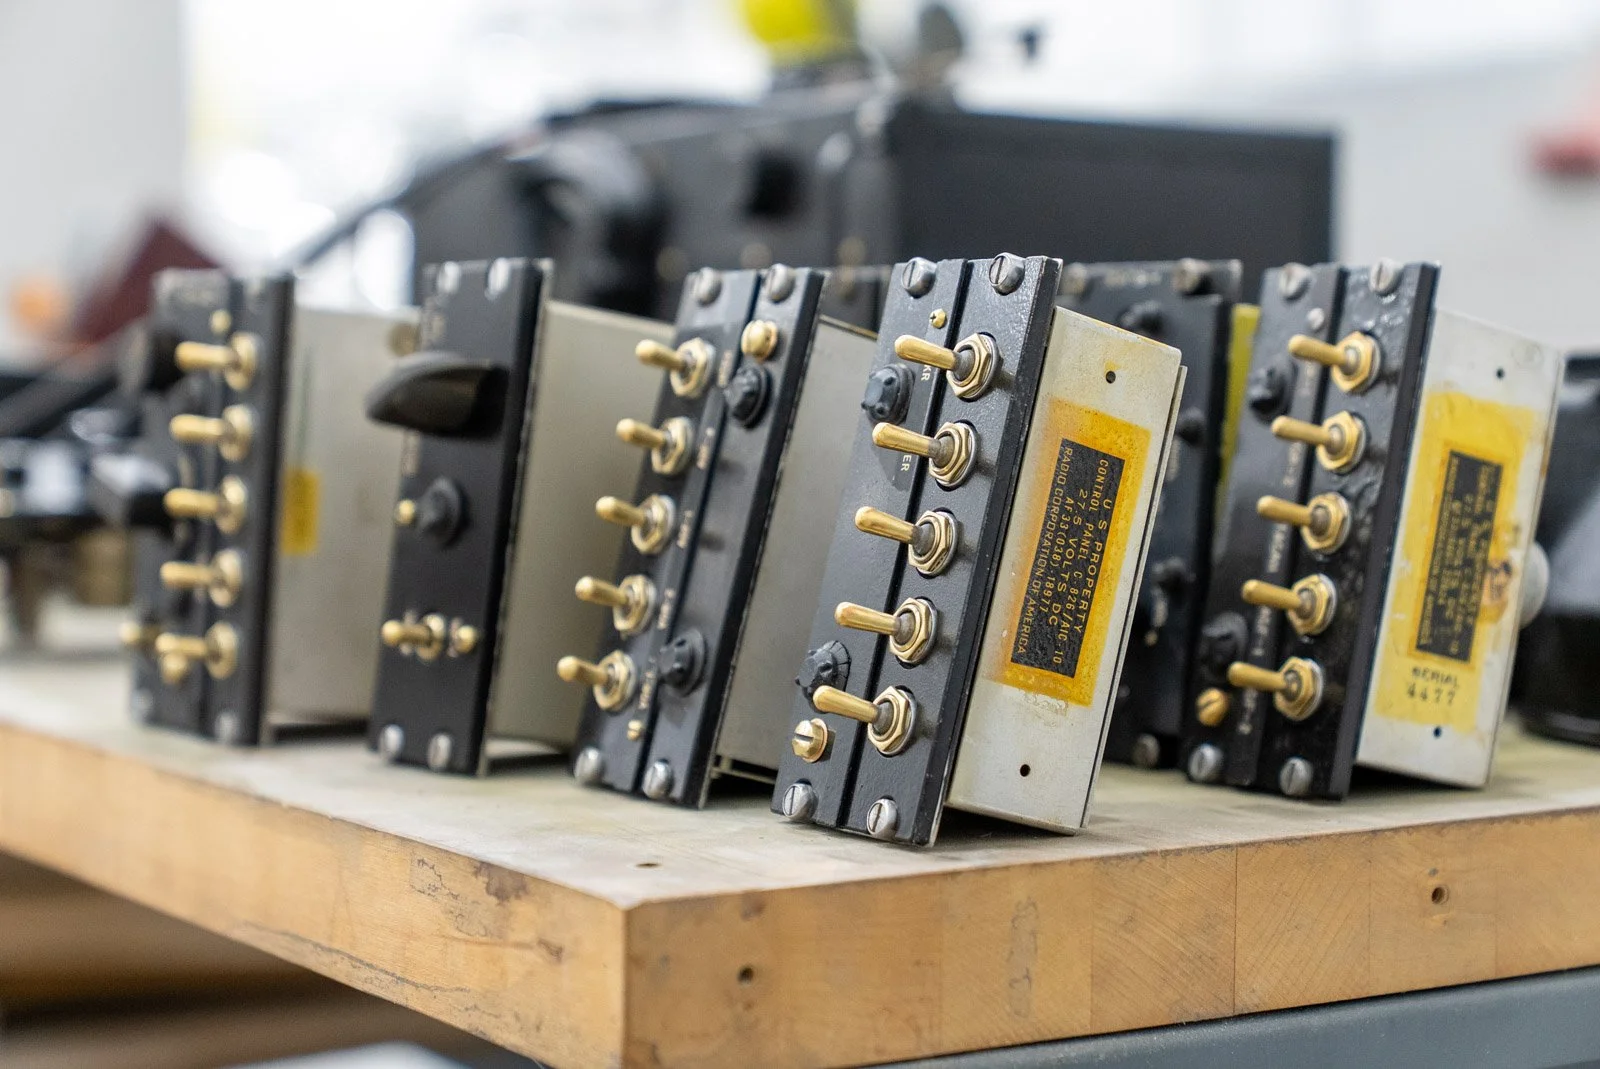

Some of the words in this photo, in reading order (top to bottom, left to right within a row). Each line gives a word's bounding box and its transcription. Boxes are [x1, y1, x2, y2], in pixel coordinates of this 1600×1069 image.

[1056, 446, 1074, 486] RADIO
[1089, 459, 1109, 512] CONTROL
[1103, 499, 1113, 510] U
[1073, 488, 1088, 526] 27.5
[1098, 520, 1107, 530] S
[1034, 487, 1064, 577] CORPORATION
[1077, 522, 1095, 560] PANEL
[1057, 538, 1079, 593] VOLTS
[1032, 580, 1042, 597] OF
[1074, 541, 1103, 633] PROPERTY
[1017, 597, 1036, 655] AMERICA
[1048, 603, 1061, 626] DC
[1412, 667, 1459, 689] SERIAL
